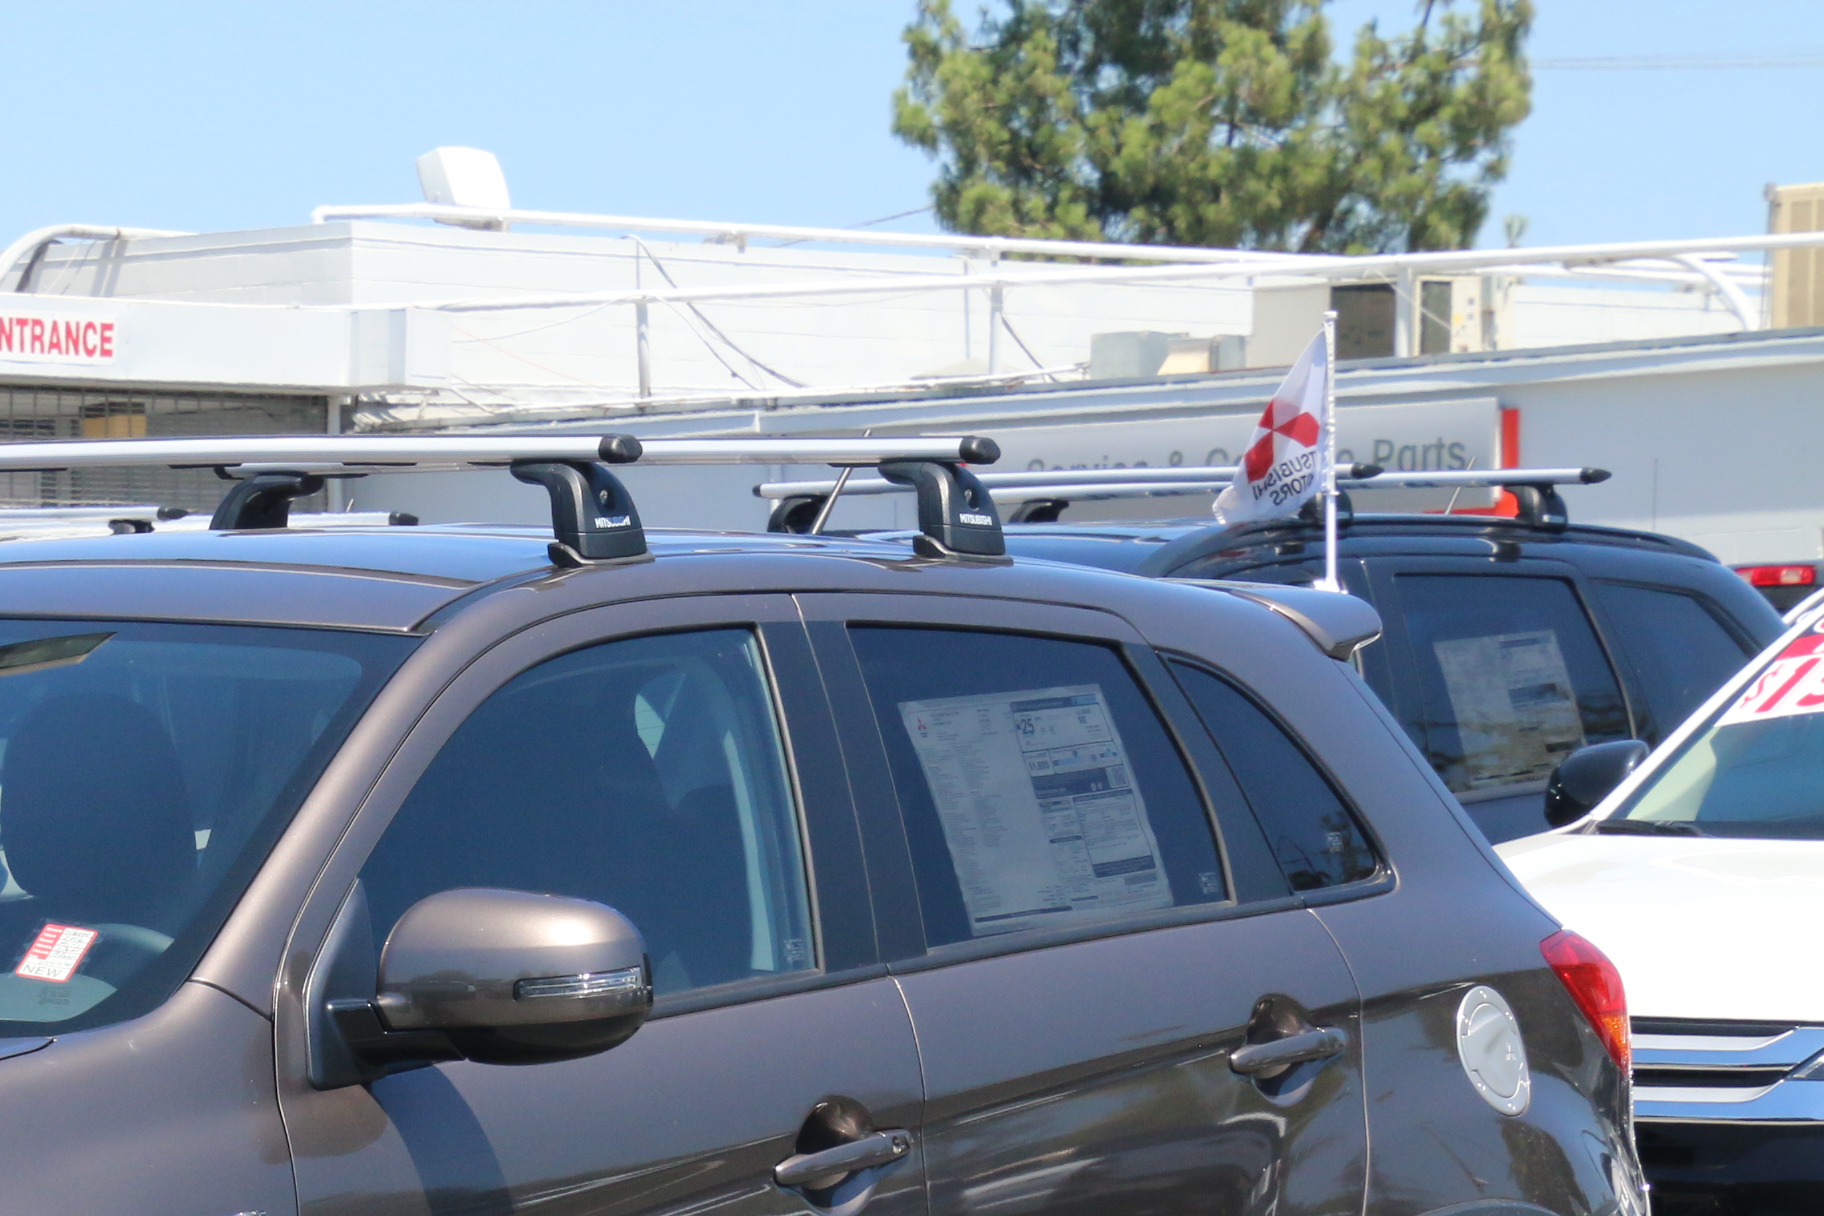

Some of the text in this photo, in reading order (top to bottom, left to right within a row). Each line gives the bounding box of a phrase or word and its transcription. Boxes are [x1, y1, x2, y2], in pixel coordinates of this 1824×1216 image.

[1373, 437, 1466, 471] Parts
[959, 512, 993, 526] MITSUBISHI
[22, 964, 63, 978] NEW
